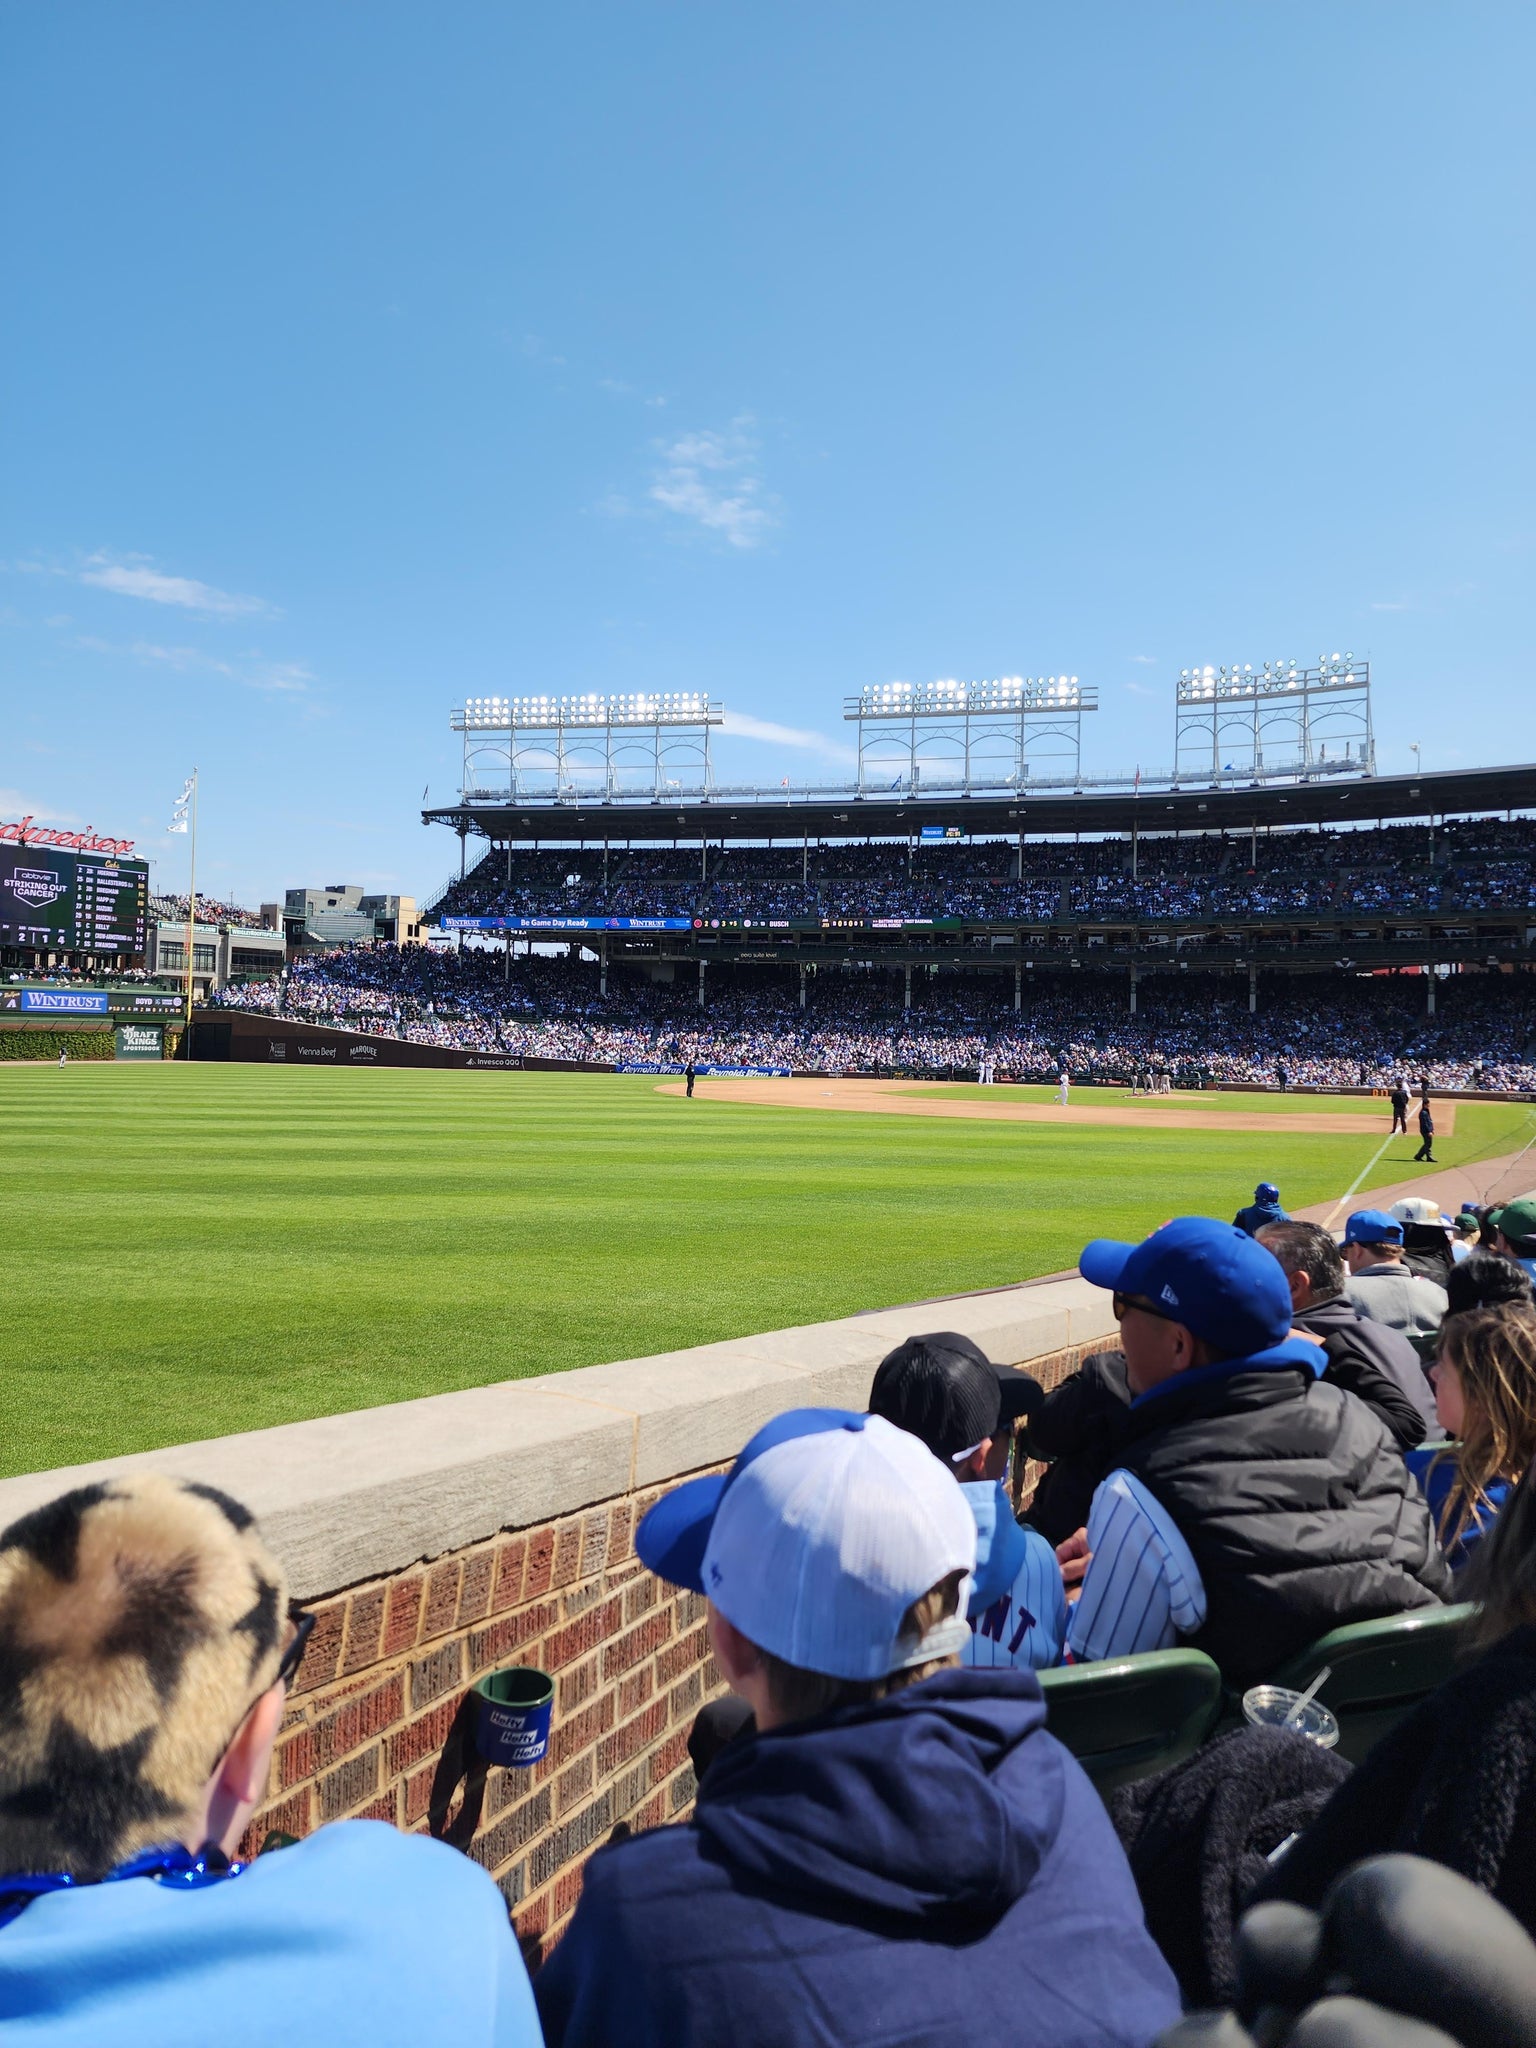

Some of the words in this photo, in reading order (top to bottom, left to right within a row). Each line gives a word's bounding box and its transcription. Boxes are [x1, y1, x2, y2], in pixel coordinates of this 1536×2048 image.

[4, 879, 48, 890] STRIKING
[17, 888, 54, 898] CANCER
[553, 919, 565, 928] Day
[567, 919, 588, 928] Ready
[19, 933, 26, 941] 2
[42, 935, 48, 943] 1
[58, 936, 65, 944] 4
[28, 992, 104, 1007] WINTRUST
[123, 1031, 159, 1039] DRAFT
[298, 1046, 320, 1056] Vienna
[321, 1047, 336, 1058] Beef
[350, 1045, 377, 1057] MARQUEE
[622, 1066, 659, 1074] Reynolds
[659, 1066, 682, 1074] Wrap
[707, 1068, 746, 1077] Reynolds
[492, 1712, 523, 1728] Hefty
[503, 1730, 536, 1744] Hefty
[514, 1744, 543, 1759] Hefty
